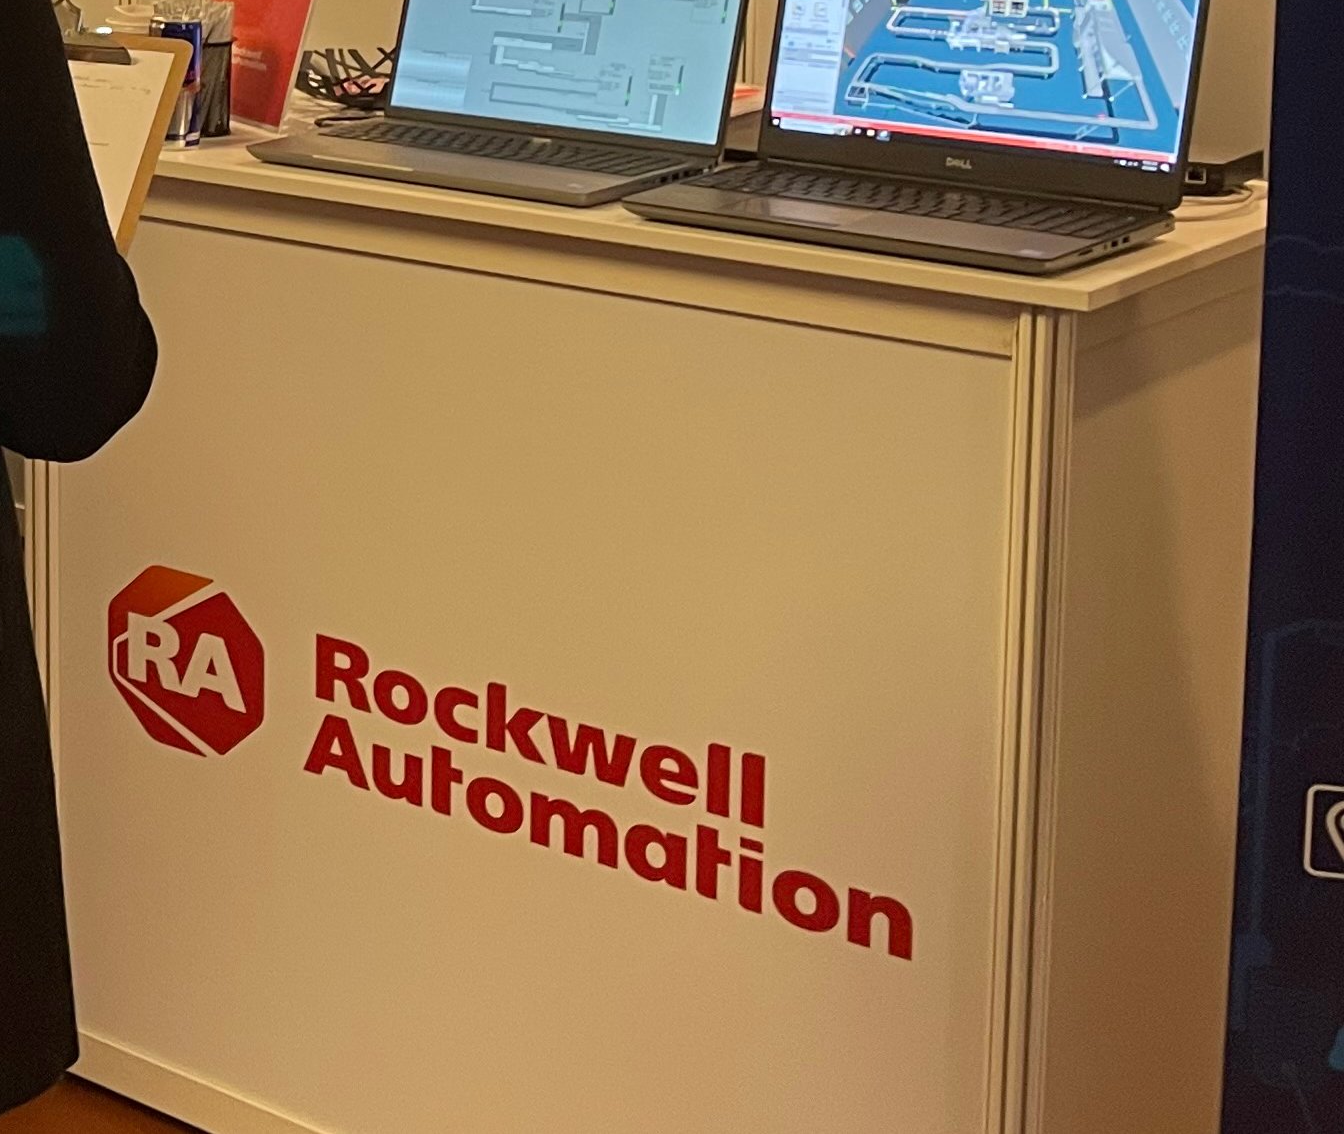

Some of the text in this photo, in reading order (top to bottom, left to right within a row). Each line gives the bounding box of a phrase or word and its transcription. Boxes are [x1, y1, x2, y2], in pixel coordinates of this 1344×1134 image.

[945, 156, 973, 170] DELL
[127, 611, 247, 714] RA
[315, 632, 766, 829] Rockwell
[303, 713, 913, 961] Automation
